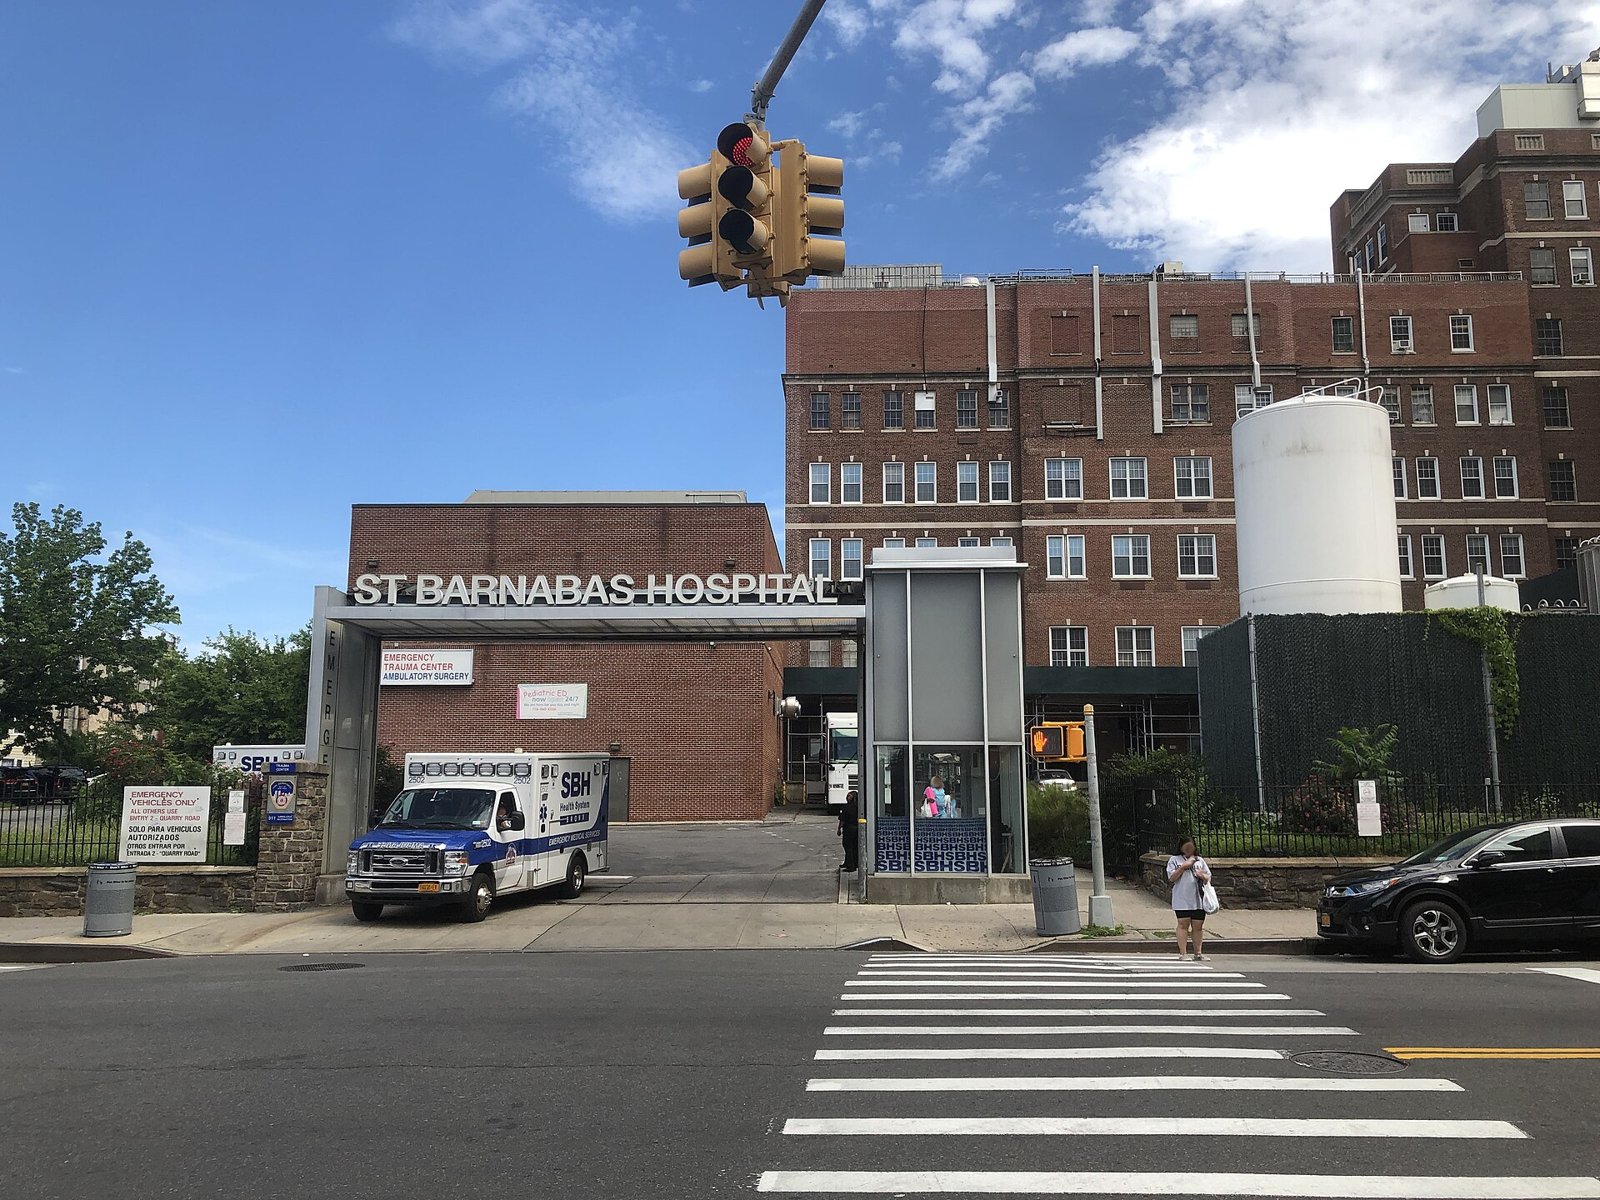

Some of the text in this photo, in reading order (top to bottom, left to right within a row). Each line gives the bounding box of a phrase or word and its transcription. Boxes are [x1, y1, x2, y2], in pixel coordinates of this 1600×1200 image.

[353, 572, 838, 606] ST BARNABAS HOSPITAL
[384, 653, 435, 662] EMERGENCY
[384, 663, 453, 671] TRAUMA CENTER
[383, 672, 469, 681] AMBULATORY SURGERY
[556, 689, 568, 697] ED
[561, 771, 591, 799] SBH
[560, 801, 590, 811] Health System
[128, 825, 202, 833] SOLO PARA VEHICULOS
[549, 835, 571, 846] EMERGENCY
